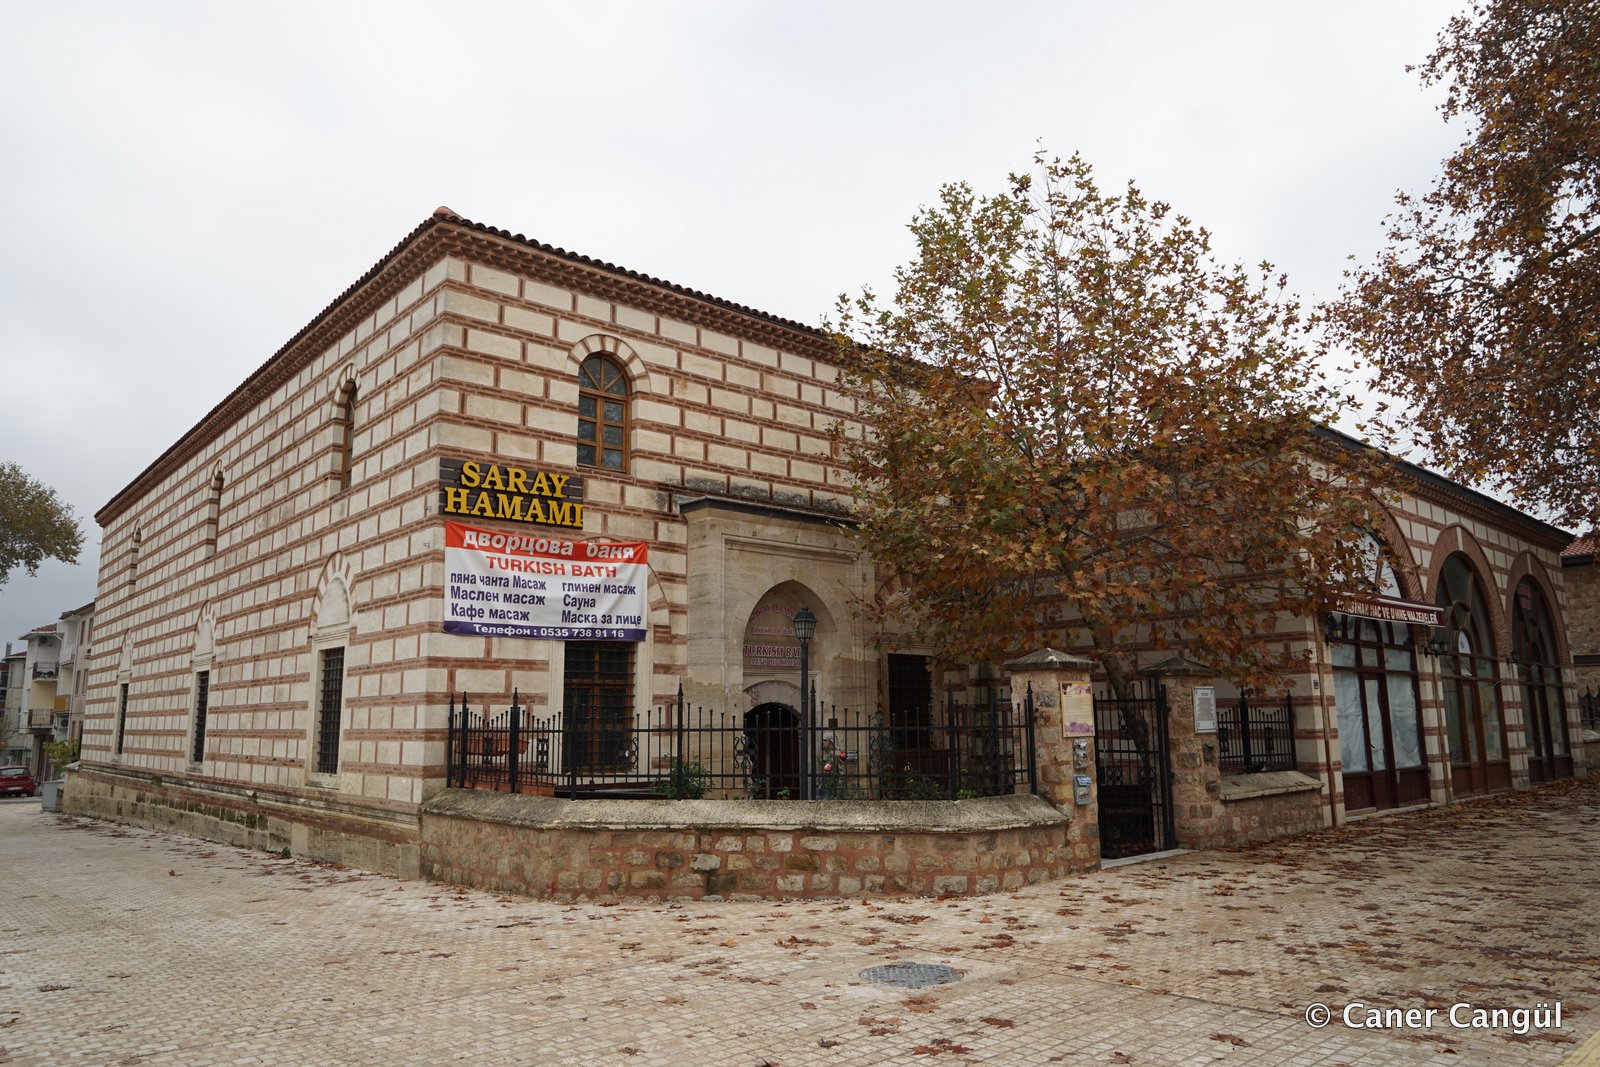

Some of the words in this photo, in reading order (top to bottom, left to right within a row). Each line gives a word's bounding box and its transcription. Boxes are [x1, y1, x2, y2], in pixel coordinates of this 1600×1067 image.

[461, 461, 570, 498] SARAY
[444, 487, 584, 527] HAMAMI
[463, 530, 574, 556] дворцова
[586, 542, 635, 559] баня
[486, 555, 566, 576] TURKISH
[571, 564, 617, 578] BATH
[450, 573, 477, 585] пяна
[479, 575, 510, 588] чанта
[512, 575, 547, 591] Масаж
[562, 582, 601, 594] глинен
[603, 584, 637, 596] масаж
[450, 586, 500, 603] Маслен
[503, 592, 546, 606] масаж
[563, 594, 596, 610] Сауна
[451, 603, 485, 621] Кафе
[489, 608, 530, 621] масаж
[561, 610, 598, 624] Маска
[601, 614, 613, 625] за
[615, 615, 642, 627] лице
[1381, 606, 1391, 619] VE
[473, 624, 531, 636] Телефон
[540, 628, 569, 637] 0535
[571, 628, 592, 638] 738
[595, 629, 607, 638] 91
[611, 629, 625, 638] 16
[743, 645, 784, 658] TURKISH
[786, 646, 802, 658] BAT
